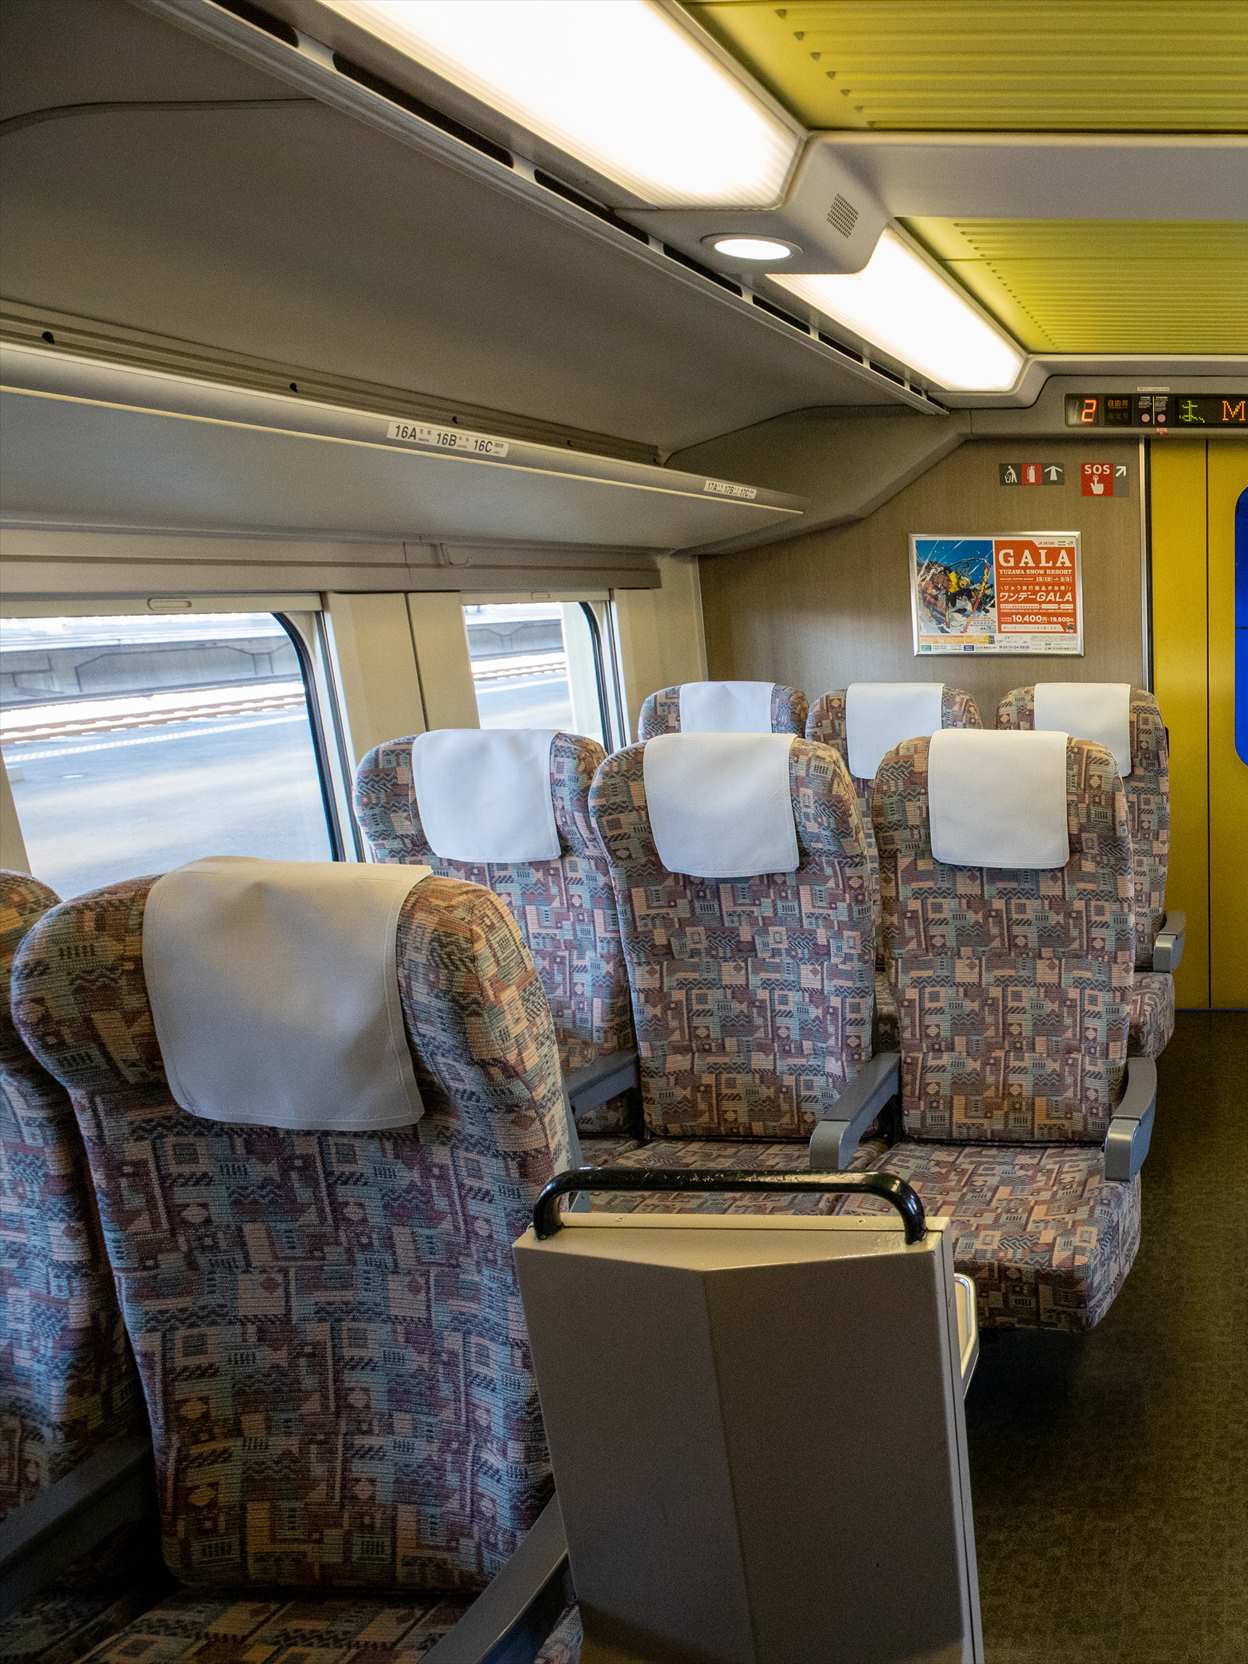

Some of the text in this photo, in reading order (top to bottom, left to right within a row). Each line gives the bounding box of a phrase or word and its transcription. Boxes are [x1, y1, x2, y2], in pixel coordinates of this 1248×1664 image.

[1081, 399, 1096, 422] 2
[395, 424, 417, 441] 16A
[436, 431, 457, 447] 16B
[473, 439, 493, 454] 16C
[1084, 464, 1111, 475] SOS
[998, 548, 1073, 567] GALA
[999, 591, 1073, 602] ワンデーGALA
